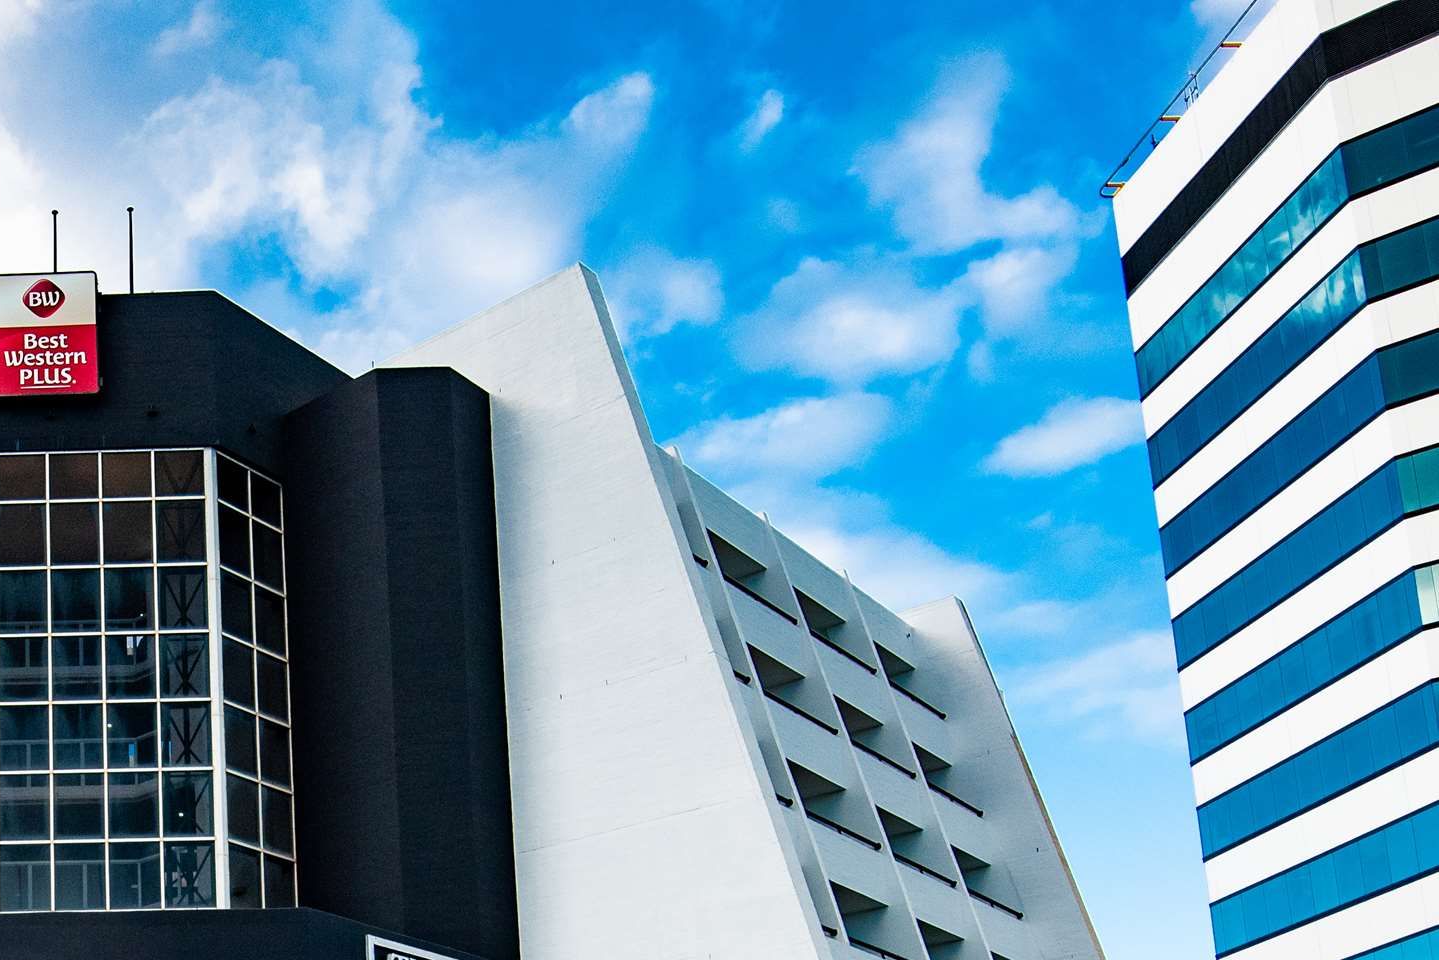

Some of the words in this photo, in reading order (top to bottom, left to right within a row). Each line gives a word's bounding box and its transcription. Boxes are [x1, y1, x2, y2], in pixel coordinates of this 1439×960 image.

[29, 290, 60, 307] BW
[24, 333, 68, 349] Best
[4, 350, 87, 367] Western
